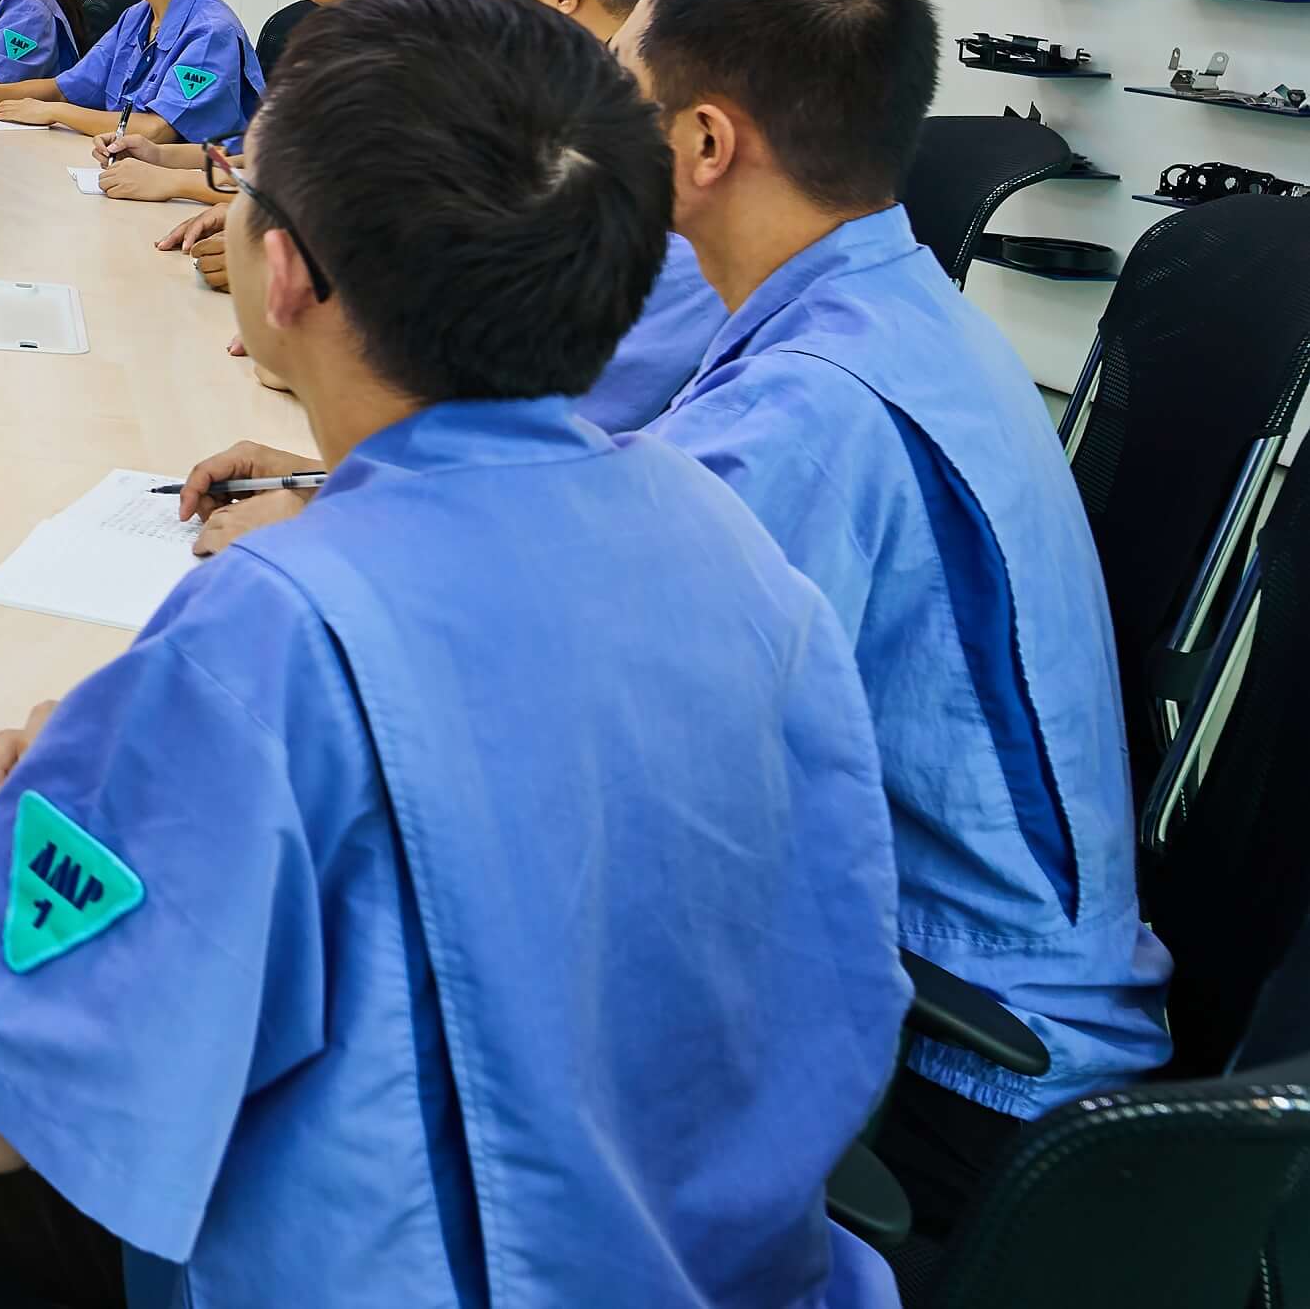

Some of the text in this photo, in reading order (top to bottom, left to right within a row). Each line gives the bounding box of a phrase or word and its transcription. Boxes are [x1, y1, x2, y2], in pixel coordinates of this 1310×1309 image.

[183, 72, 206, 83] AMP
[28, 841, 105, 912] AMP
[32, 898, 53, 930] 1
